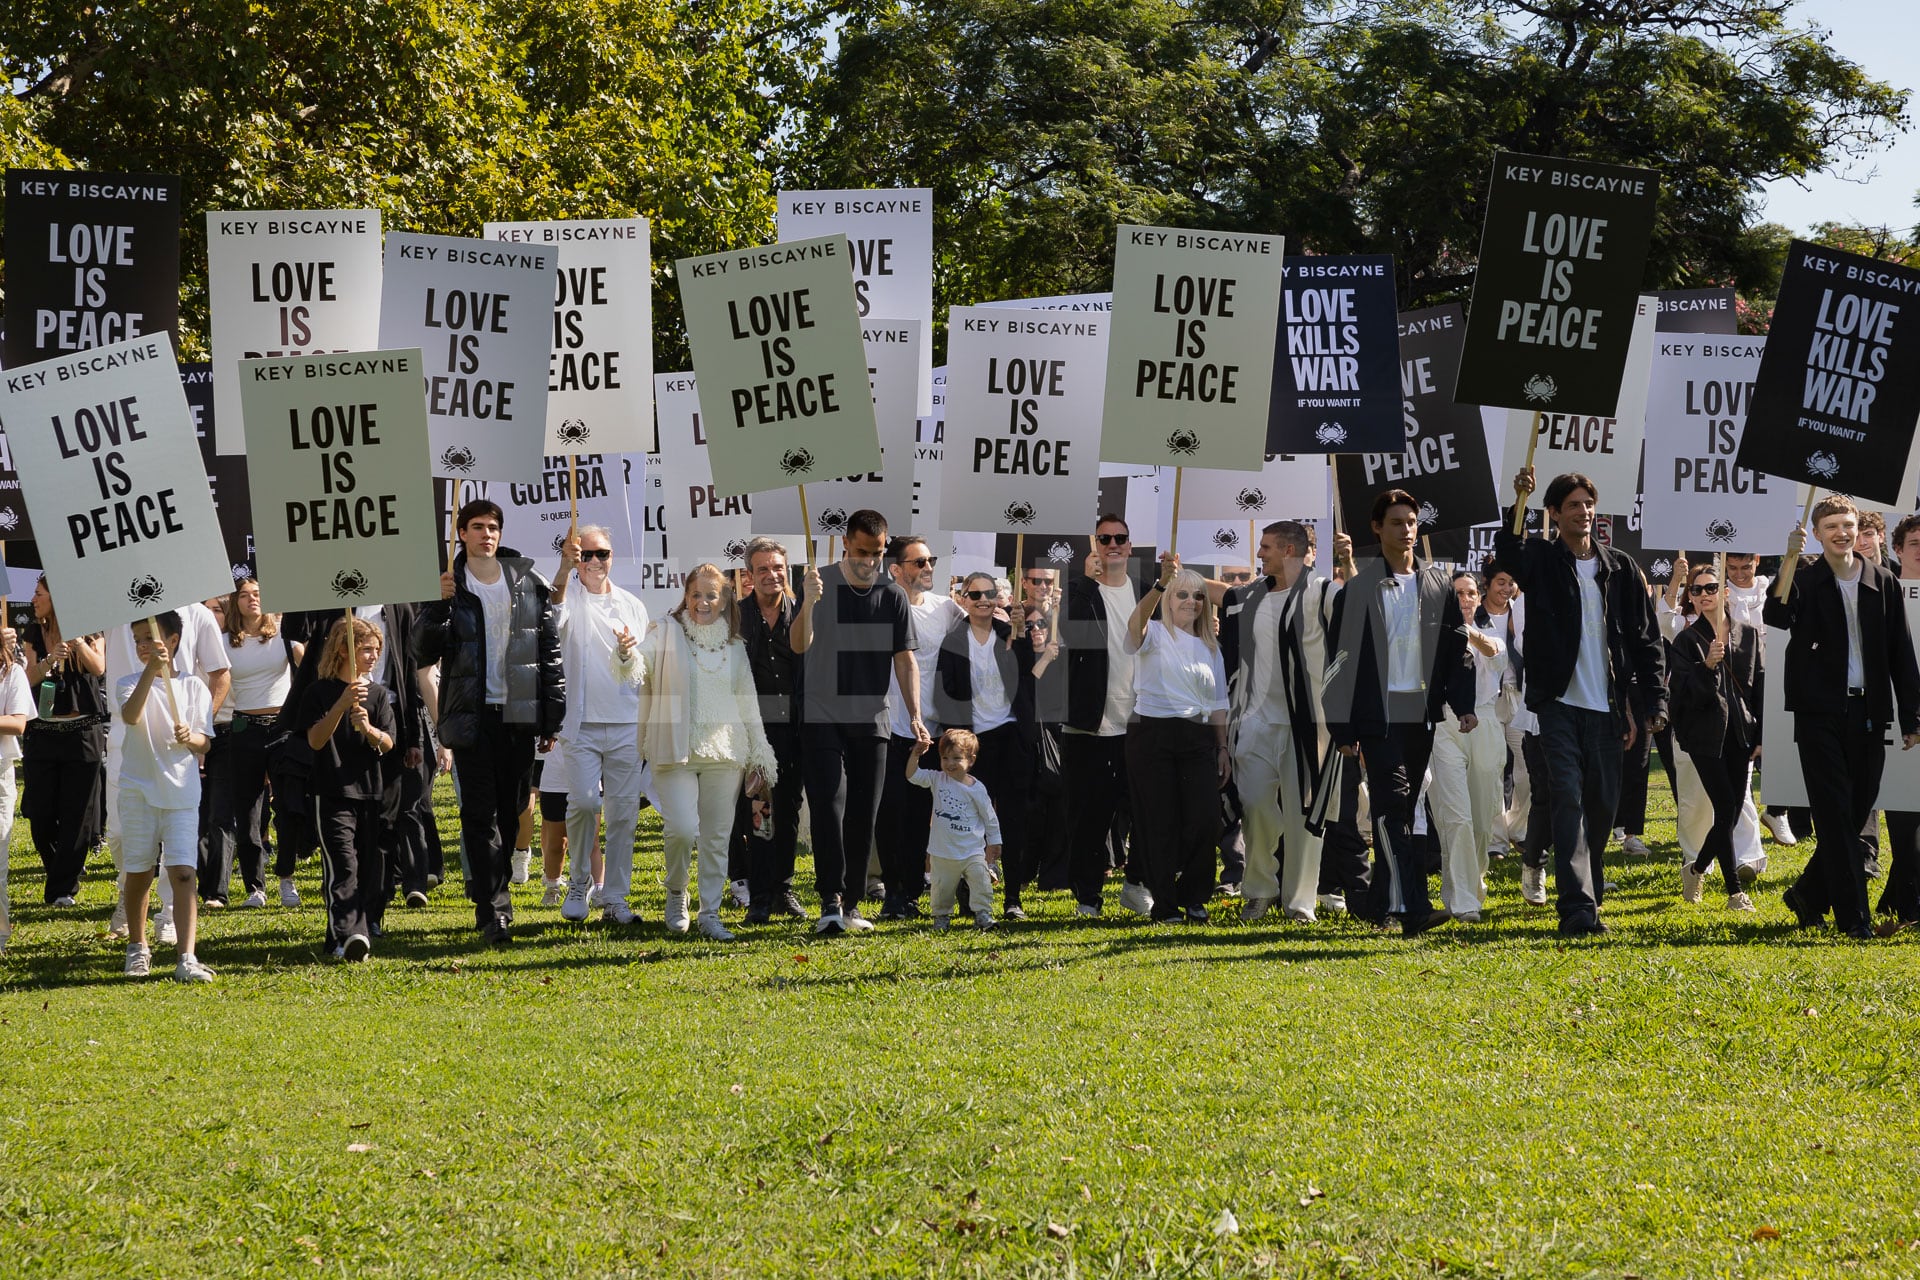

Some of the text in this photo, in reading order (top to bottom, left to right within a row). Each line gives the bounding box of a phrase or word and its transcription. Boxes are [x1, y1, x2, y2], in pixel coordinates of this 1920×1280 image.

[21, 181, 167, 202] KEY BISCAYNE
[1506, 165, 1645, 196] KEY BISCAYNE
[221, 220, 366, 235] KEY BISCAYNE
[792, 201, 921, 215] KEY BISCAYNE
[49, 223, 134, 266] LOVE
[498, 227, 636, 242] KEY BISCAYNE
[1131, 232, 1271, 254] KEY BISCAYNE
[1523, 211, 1608, 260] LOVE
[401, 245, 545, 270] KEY BISCAYNE
[692, 243, 835, 278] KEY BISCAYNE
[849, 239, 893, 276] VE
[1300, 265, 1384, 277] BISCAYNE
[1803, 255, 1839, 275] KEY
[74, 267, 106, 307] IS
[252, 262, 336, 302] LOVE
[555, 267, 607, 306] OVE
[856, 280, 869, 317] S
[1154, 274, 1236, 318] LOVE
[1541, 259, 1574, 302] IS
[425, 288, 509, 333] LOVE
[728, 289, 815, 340] LOVE
[1285, 288, 1358, 323] LOVE
[1657, 298, 1727, 312] BISCAYNE
[1816, 288, 1900, 346] LOVE
[280, 307, 311, 346] IS
[555, 310, 584, 349] IS
[862, 330, 909, 342] AYNE
[964, 319, 1097, 337] KEY BISCAYNE
[1175, 319, 1206, 359] IS
[1288, 325, 1360, 355] KILLS
[1398, 316, 1453, 336] CAYNE
[1497, 300, 1602, 350] PEACE
[8, 344, 159, 393] KEY BISCAYNE
[255, 359, 408, 381] KEY BISCAYNE
[448, 334, 479, 374] IS
[761, 337, 795, 379] IS
[1661, 344, 1764, 358] KEY BISCAY
[1807, 331, 1888, 382] KILLS
[666, 380, 695, 392] KEY
[988, 358, 1065, 397] LOVE
[1136, 359, 1239, 404] PEACE
[1291, 357, 1360, 391] WAR
[1401, 357, 1436, 397] VE
[424, 376, 514, 421] EACE
[731, 373, 840, 428] PEACE
[1298, 398, 1361, 408] IF YOU WANT IT
[1802, 368, 1876, 424] WAR
[51, 396, 147, 459] LOVE
[290, 404, 380, 450] LOVE
[1009, 399, 1039, 436] IS
[1404, 401, 1420, 438] S
[1798, 417, 1866, 442] IF YOU WANT IT
[973, 438, 1071, 476] PEACE
[1708, 420, 1735, 455] IS
[92, 452, 132, 500] IS
[321, 452, 356, 494] IS
[1363, 433, 1460, 486] PEACE
[445, 480, 490, 511] LOV
[510, 466, 607, 506] GUERRA
[67, 489, 183, 559] PEACE
[286, 495, 399, 542] PEACE
[541, 513, 548, 521] SI
